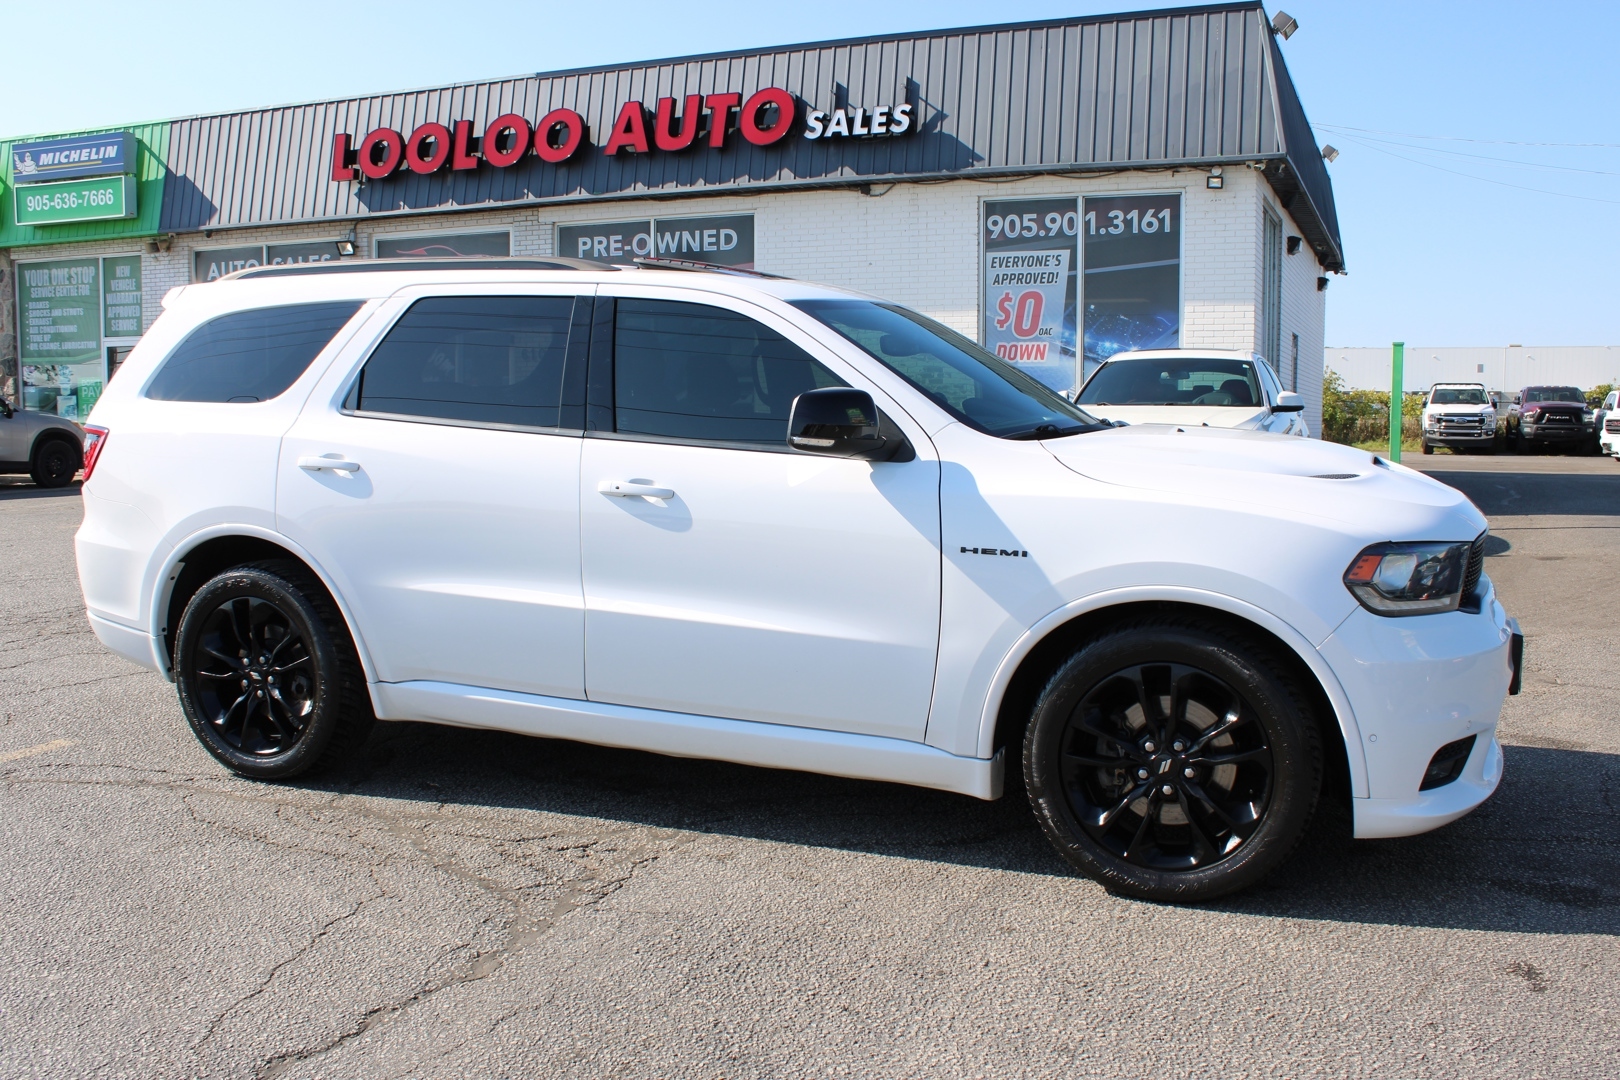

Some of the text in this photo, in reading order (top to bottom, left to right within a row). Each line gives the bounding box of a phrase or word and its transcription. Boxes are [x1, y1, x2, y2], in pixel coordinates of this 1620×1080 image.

[331, 86, 914, 182] LOOLOO AUTO SALES
[39, 145, 118, 166] MICHELIN
[27, 189, 114, 211] 905-636-7666
[987, 208, 1171, 238] 905.901.3161
[578, 229, 738, 258] PRE-OWNED
[990, 254, 1062, 269] EVERYONE'S
[24, 266, 96, 287] YOUR ONE STOP
[115, 265, 131, 278] NEW
[992, 271, 1059, 286] APPROVED!
[30, 284, 91, 298] SERVICE CENTRE FOR
[110, 278, 136, 292] VEHICLE
[106, 291, 142, 305] WARRANTY
[28, 301, 50, 310] BRAKES
[28, 307, 84, 318] SHOCKS AND STRUTS
[107, 305, 140, 318] APPROVED
[996, 291, 1044, 337] $0
[29, 317, 53, 326] EXHAUST
[111, 318, 138, 332] SERVICE
[29, 325, 78, 334] AIR CONDITIONING
[1038, 327, 1053, 336] OAC
[30, 334, 52, 343] TUNE UP
[61, 340, 97, 350] LUBRICATION
[997, 344, 1047, 361] DOWN
[81, 386, 101, 398] PAY
[960, 546, 1028, 558] HEMI
